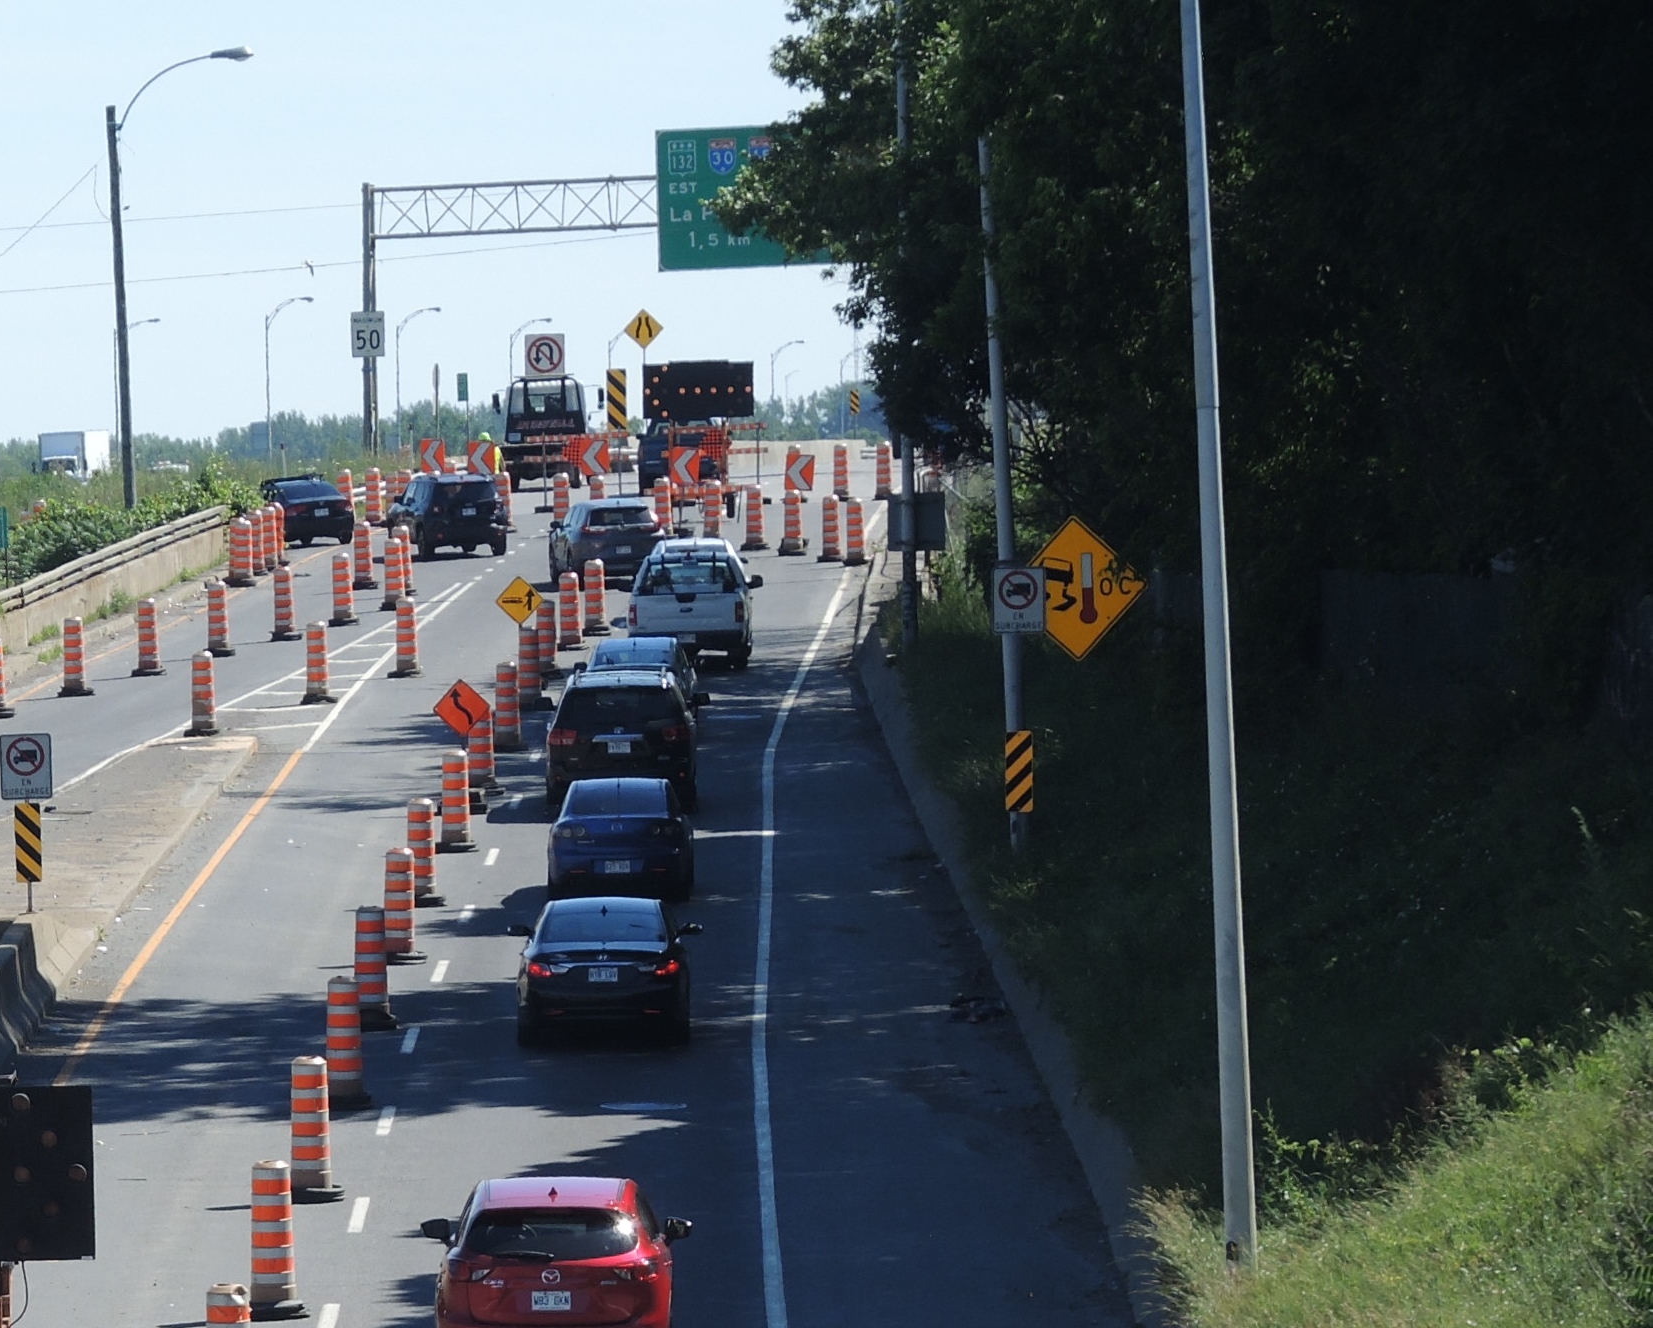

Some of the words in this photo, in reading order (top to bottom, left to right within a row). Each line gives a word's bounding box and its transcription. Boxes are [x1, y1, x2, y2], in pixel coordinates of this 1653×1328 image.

[672, 154, 693, 169] 132
[712, 151, 733, 165] 30
[669, 182, 697, 194] EST
[670, 207, 693, 222] La
[689, 231, 719, 250] 1,5
[727, 234, 751, 246] km
[356, 329, 381, 350] 50
[1013, 611, 1025, 620] EN
[21, 778, 32, 786] EN
[4, 786, 49, 796] SURCHARGE
